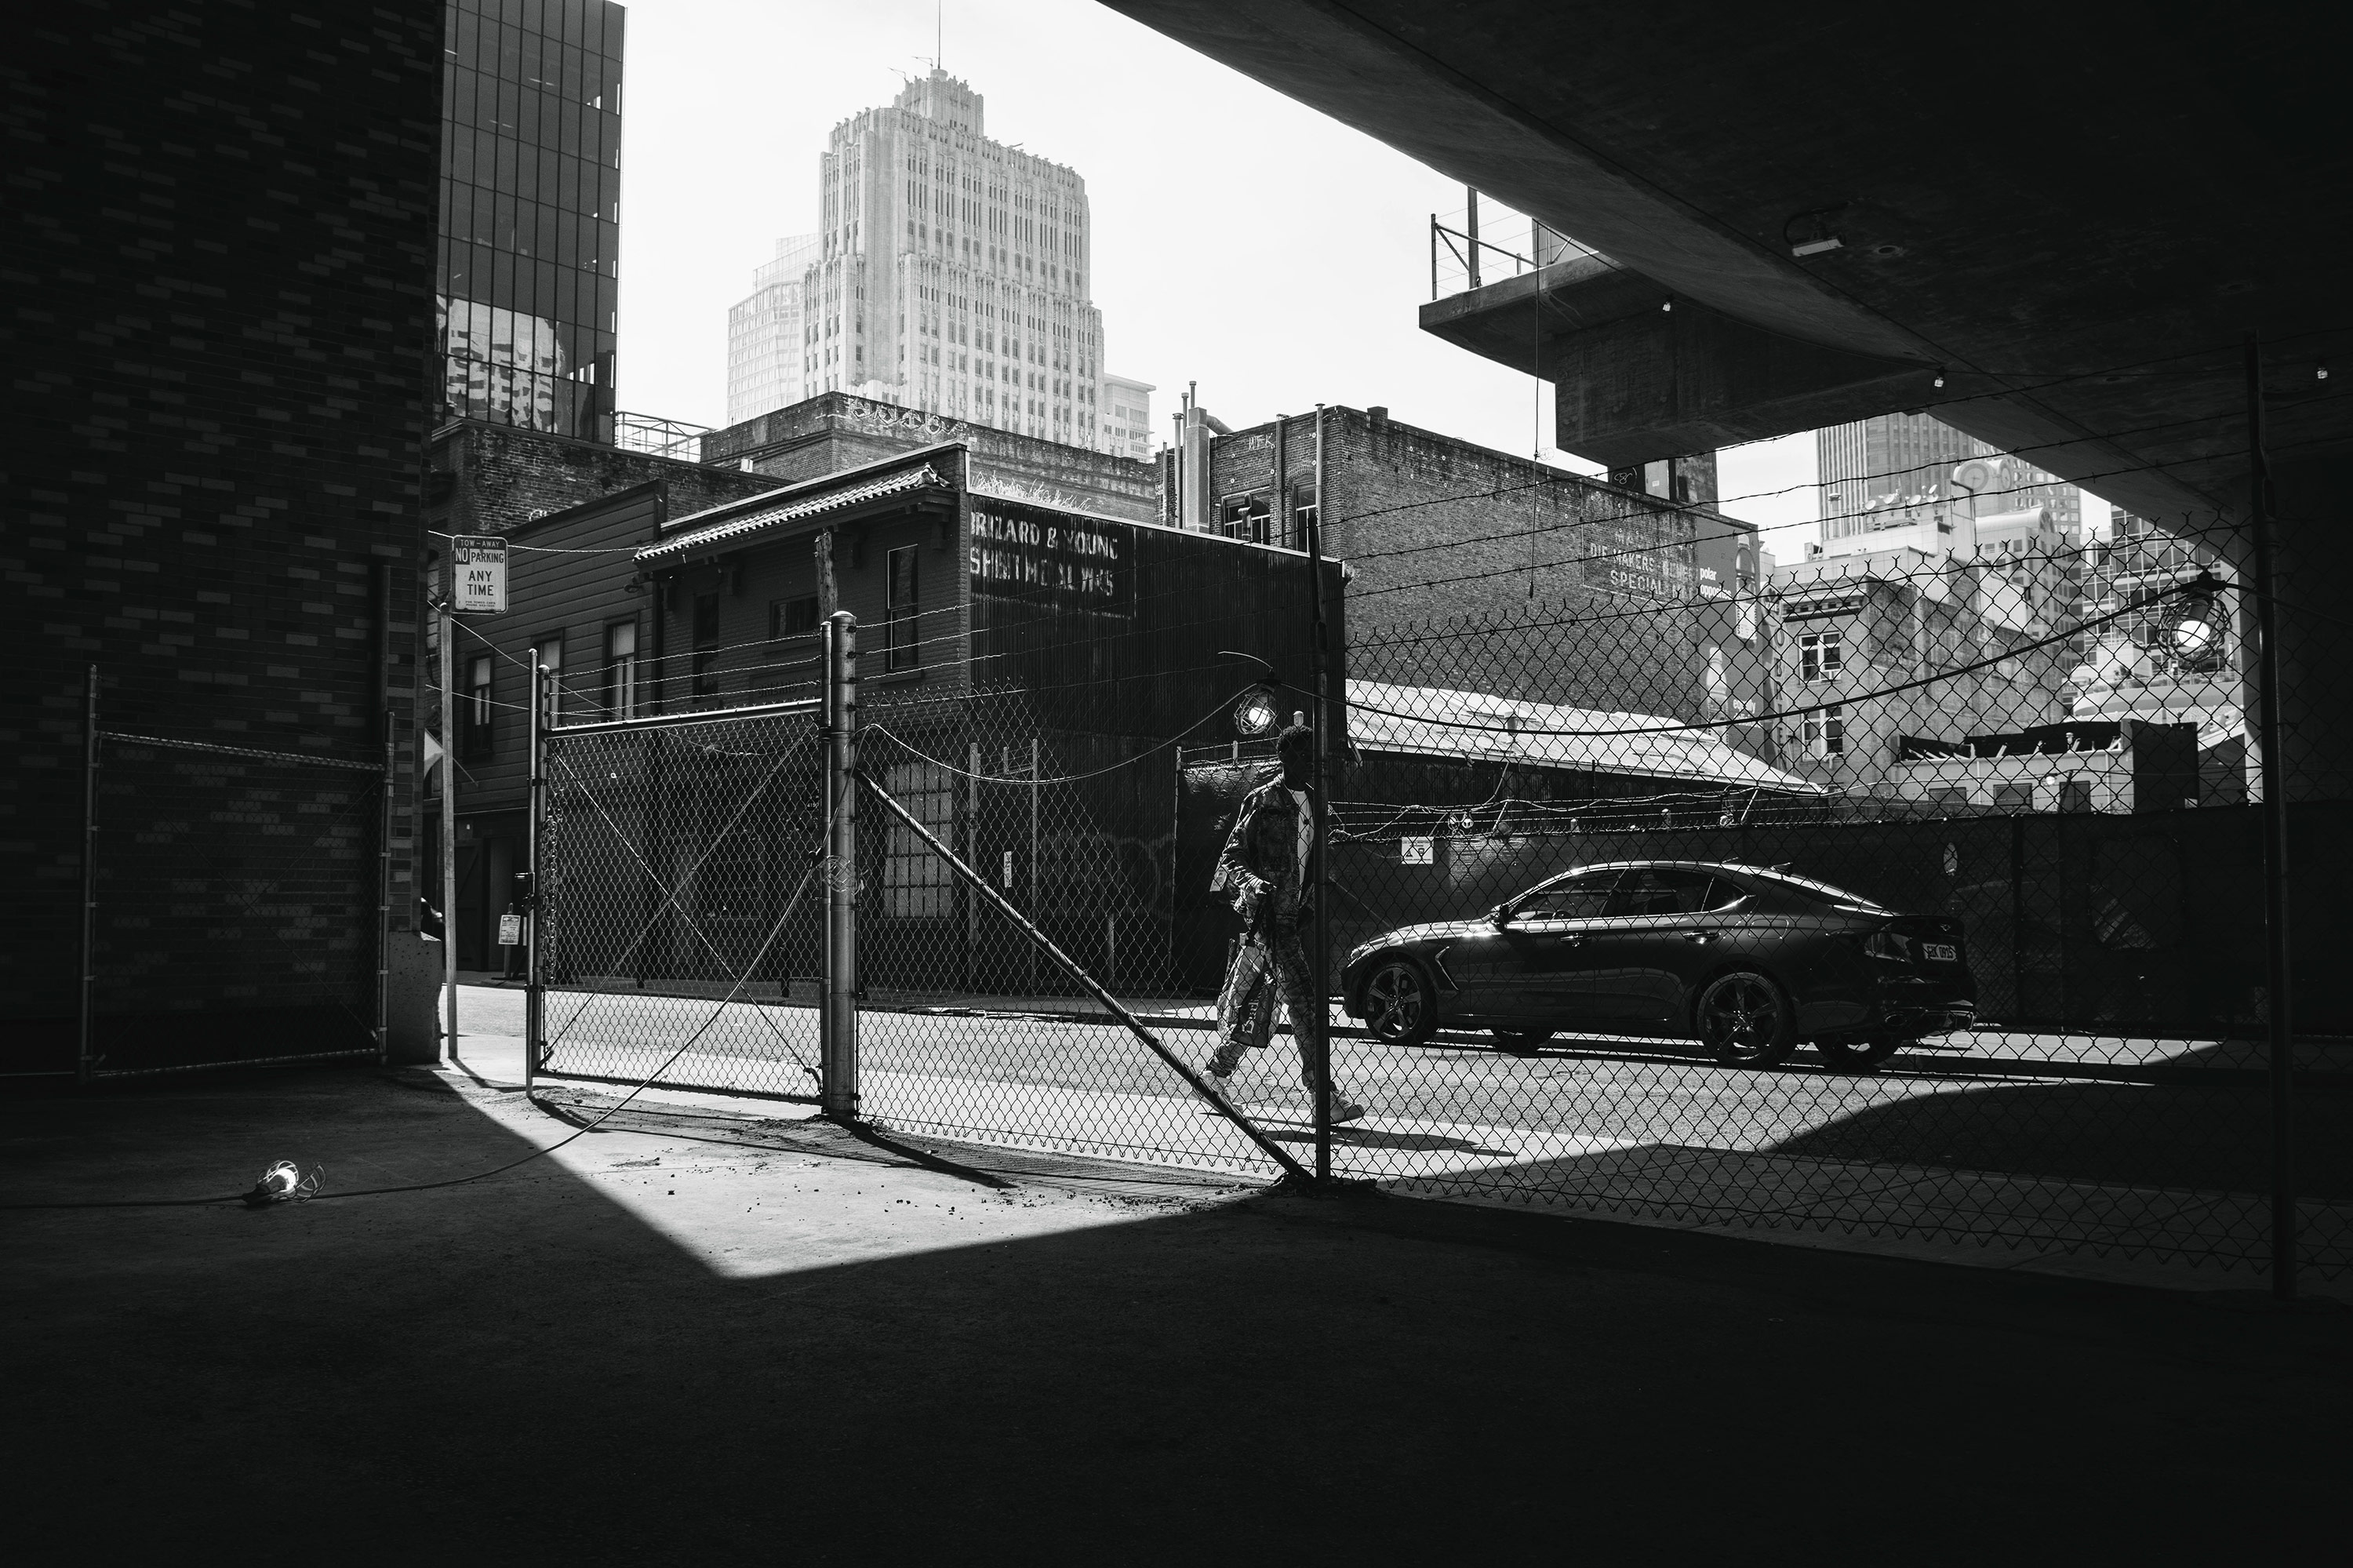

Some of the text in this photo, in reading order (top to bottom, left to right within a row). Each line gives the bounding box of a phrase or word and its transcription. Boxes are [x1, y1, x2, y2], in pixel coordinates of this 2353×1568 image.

[1047, 526, 1058, 549] &
[456, 548, 504, 563] NO PARKING
[468, 570, 493, 582] ANY
[1700, 567, 1718, 581] polar
[1610, 569, 1665, 595] SPECIAL
[467, 584, 494, 596] TIME
